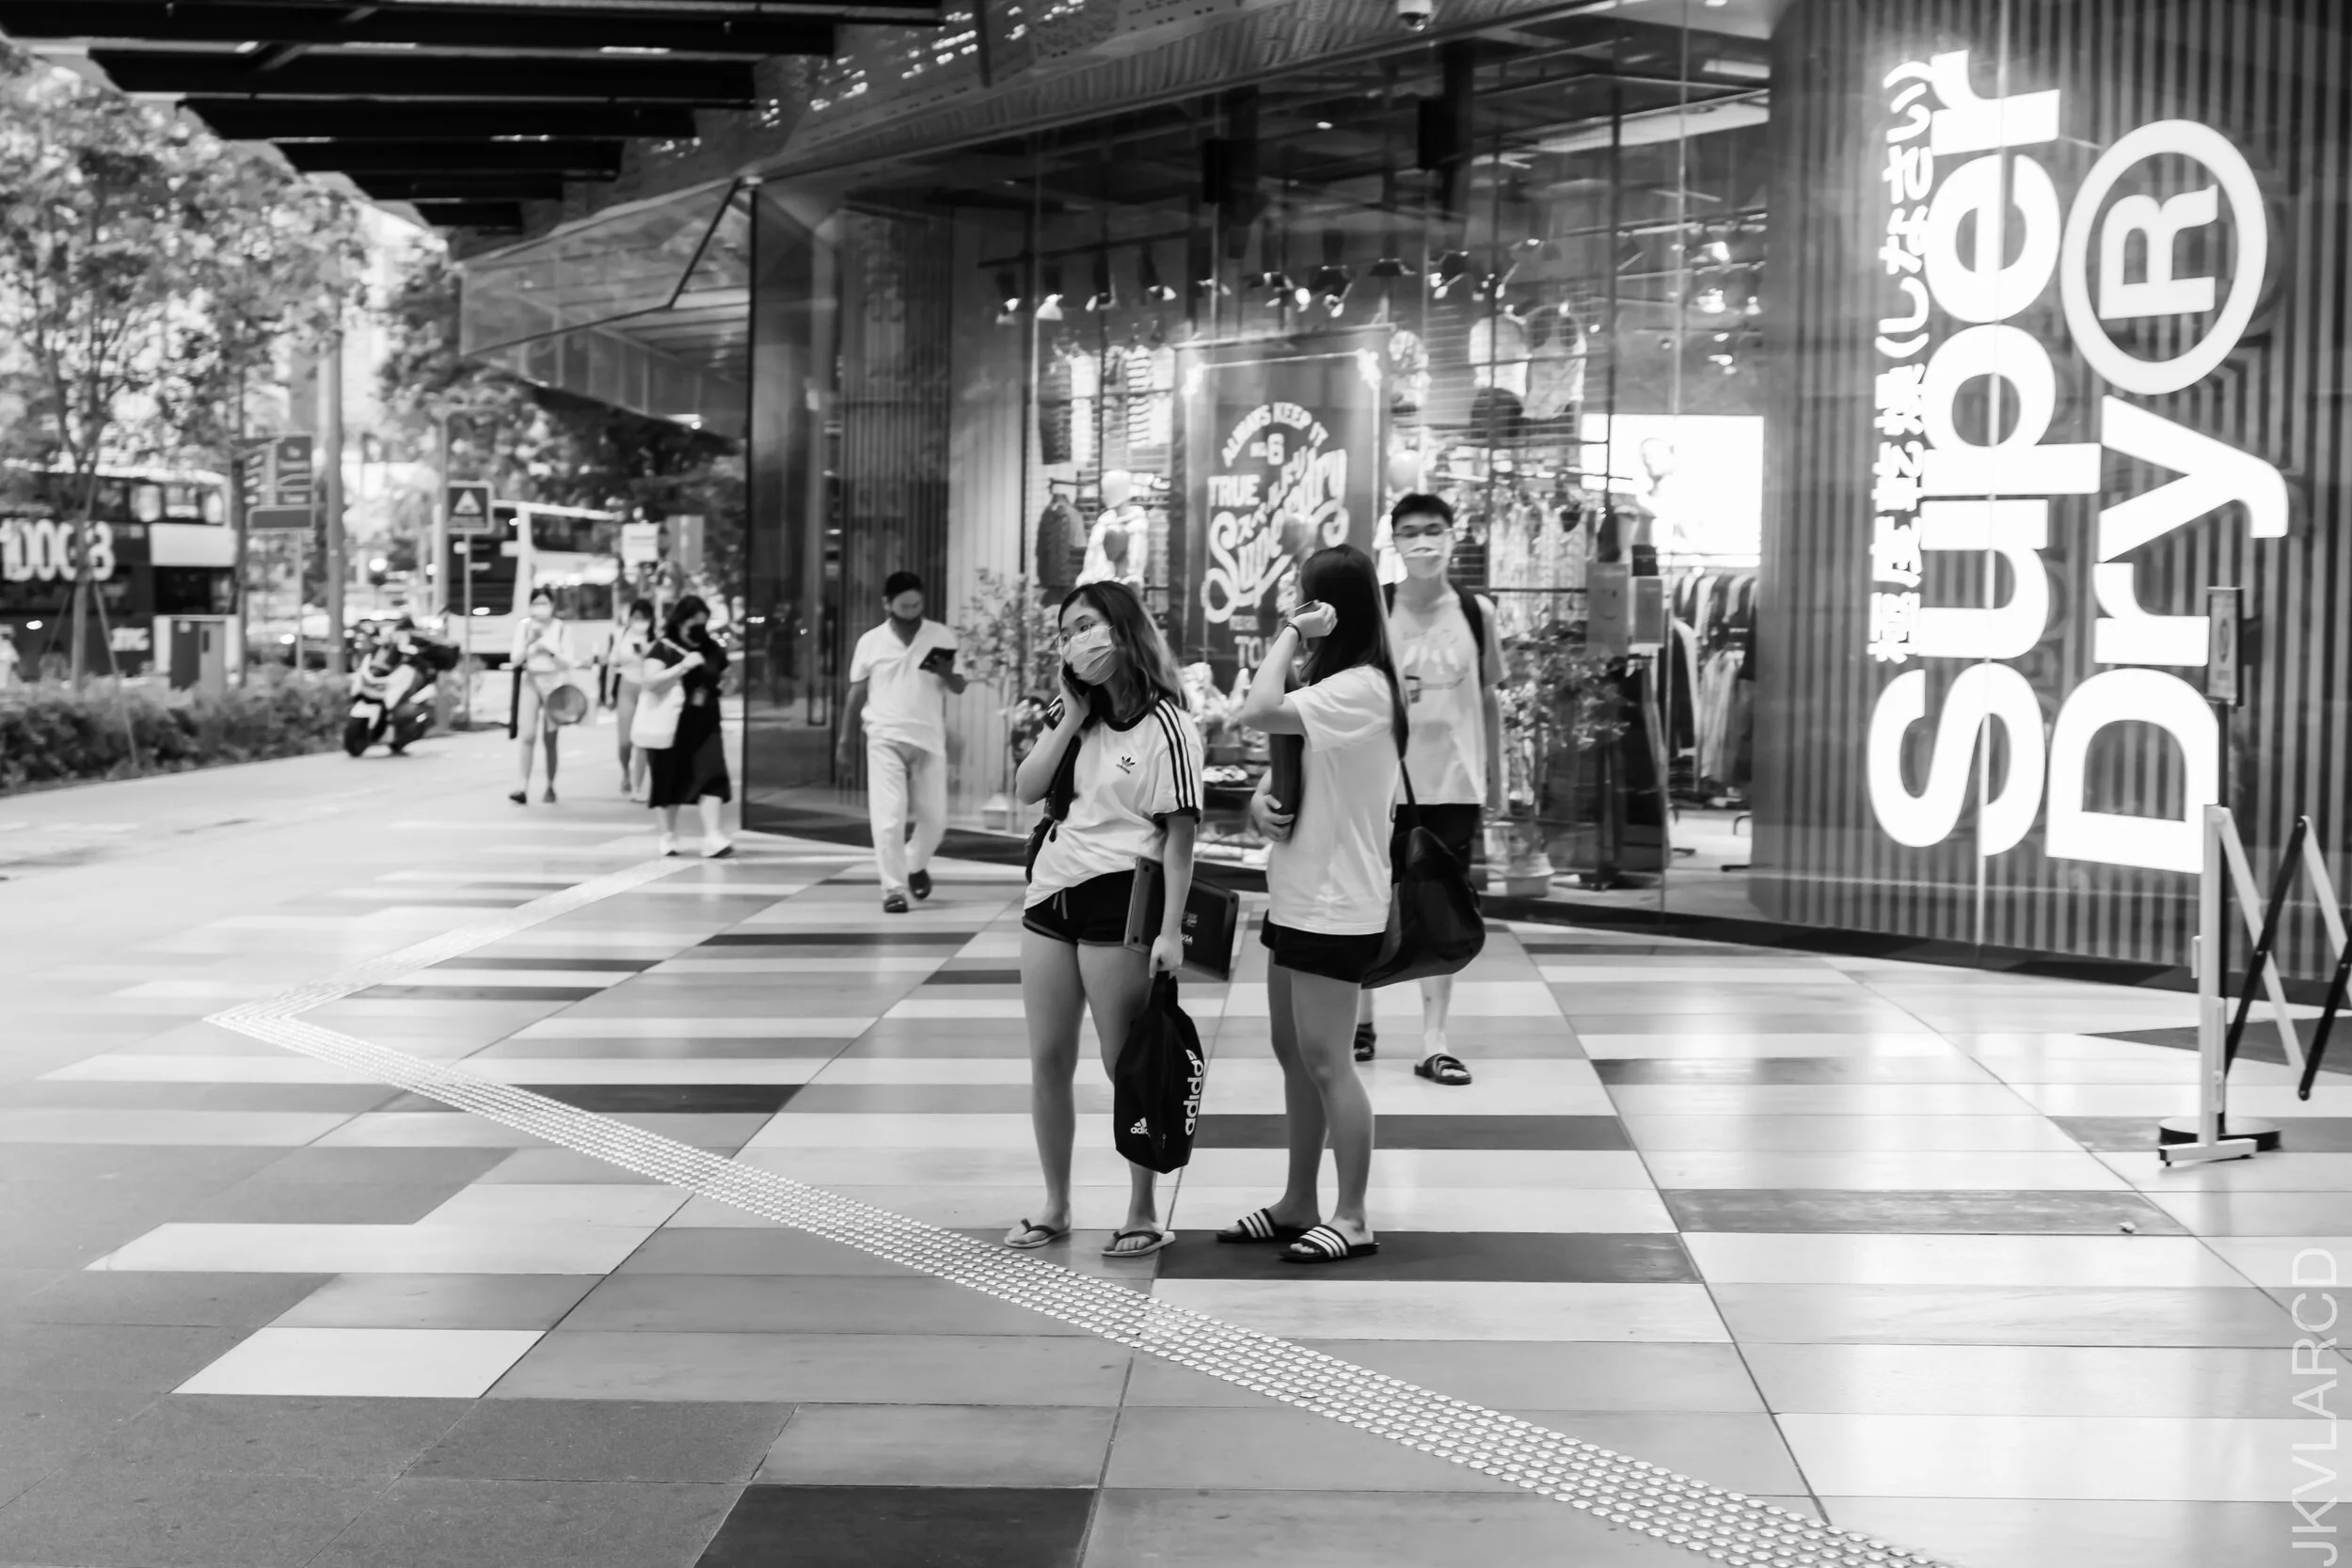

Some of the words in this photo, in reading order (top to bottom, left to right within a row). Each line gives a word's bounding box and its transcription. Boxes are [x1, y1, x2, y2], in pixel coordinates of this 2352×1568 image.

[1866, 59, 1933, 662] 極度乾燥(しなさい)
[1273, 402, 1312, 430] KEEP
[1866, 47, 2102, 856] Super
[1207, 474, 1261, 507] TRUE
[1183, 1049, 1204, 1136] adidas
